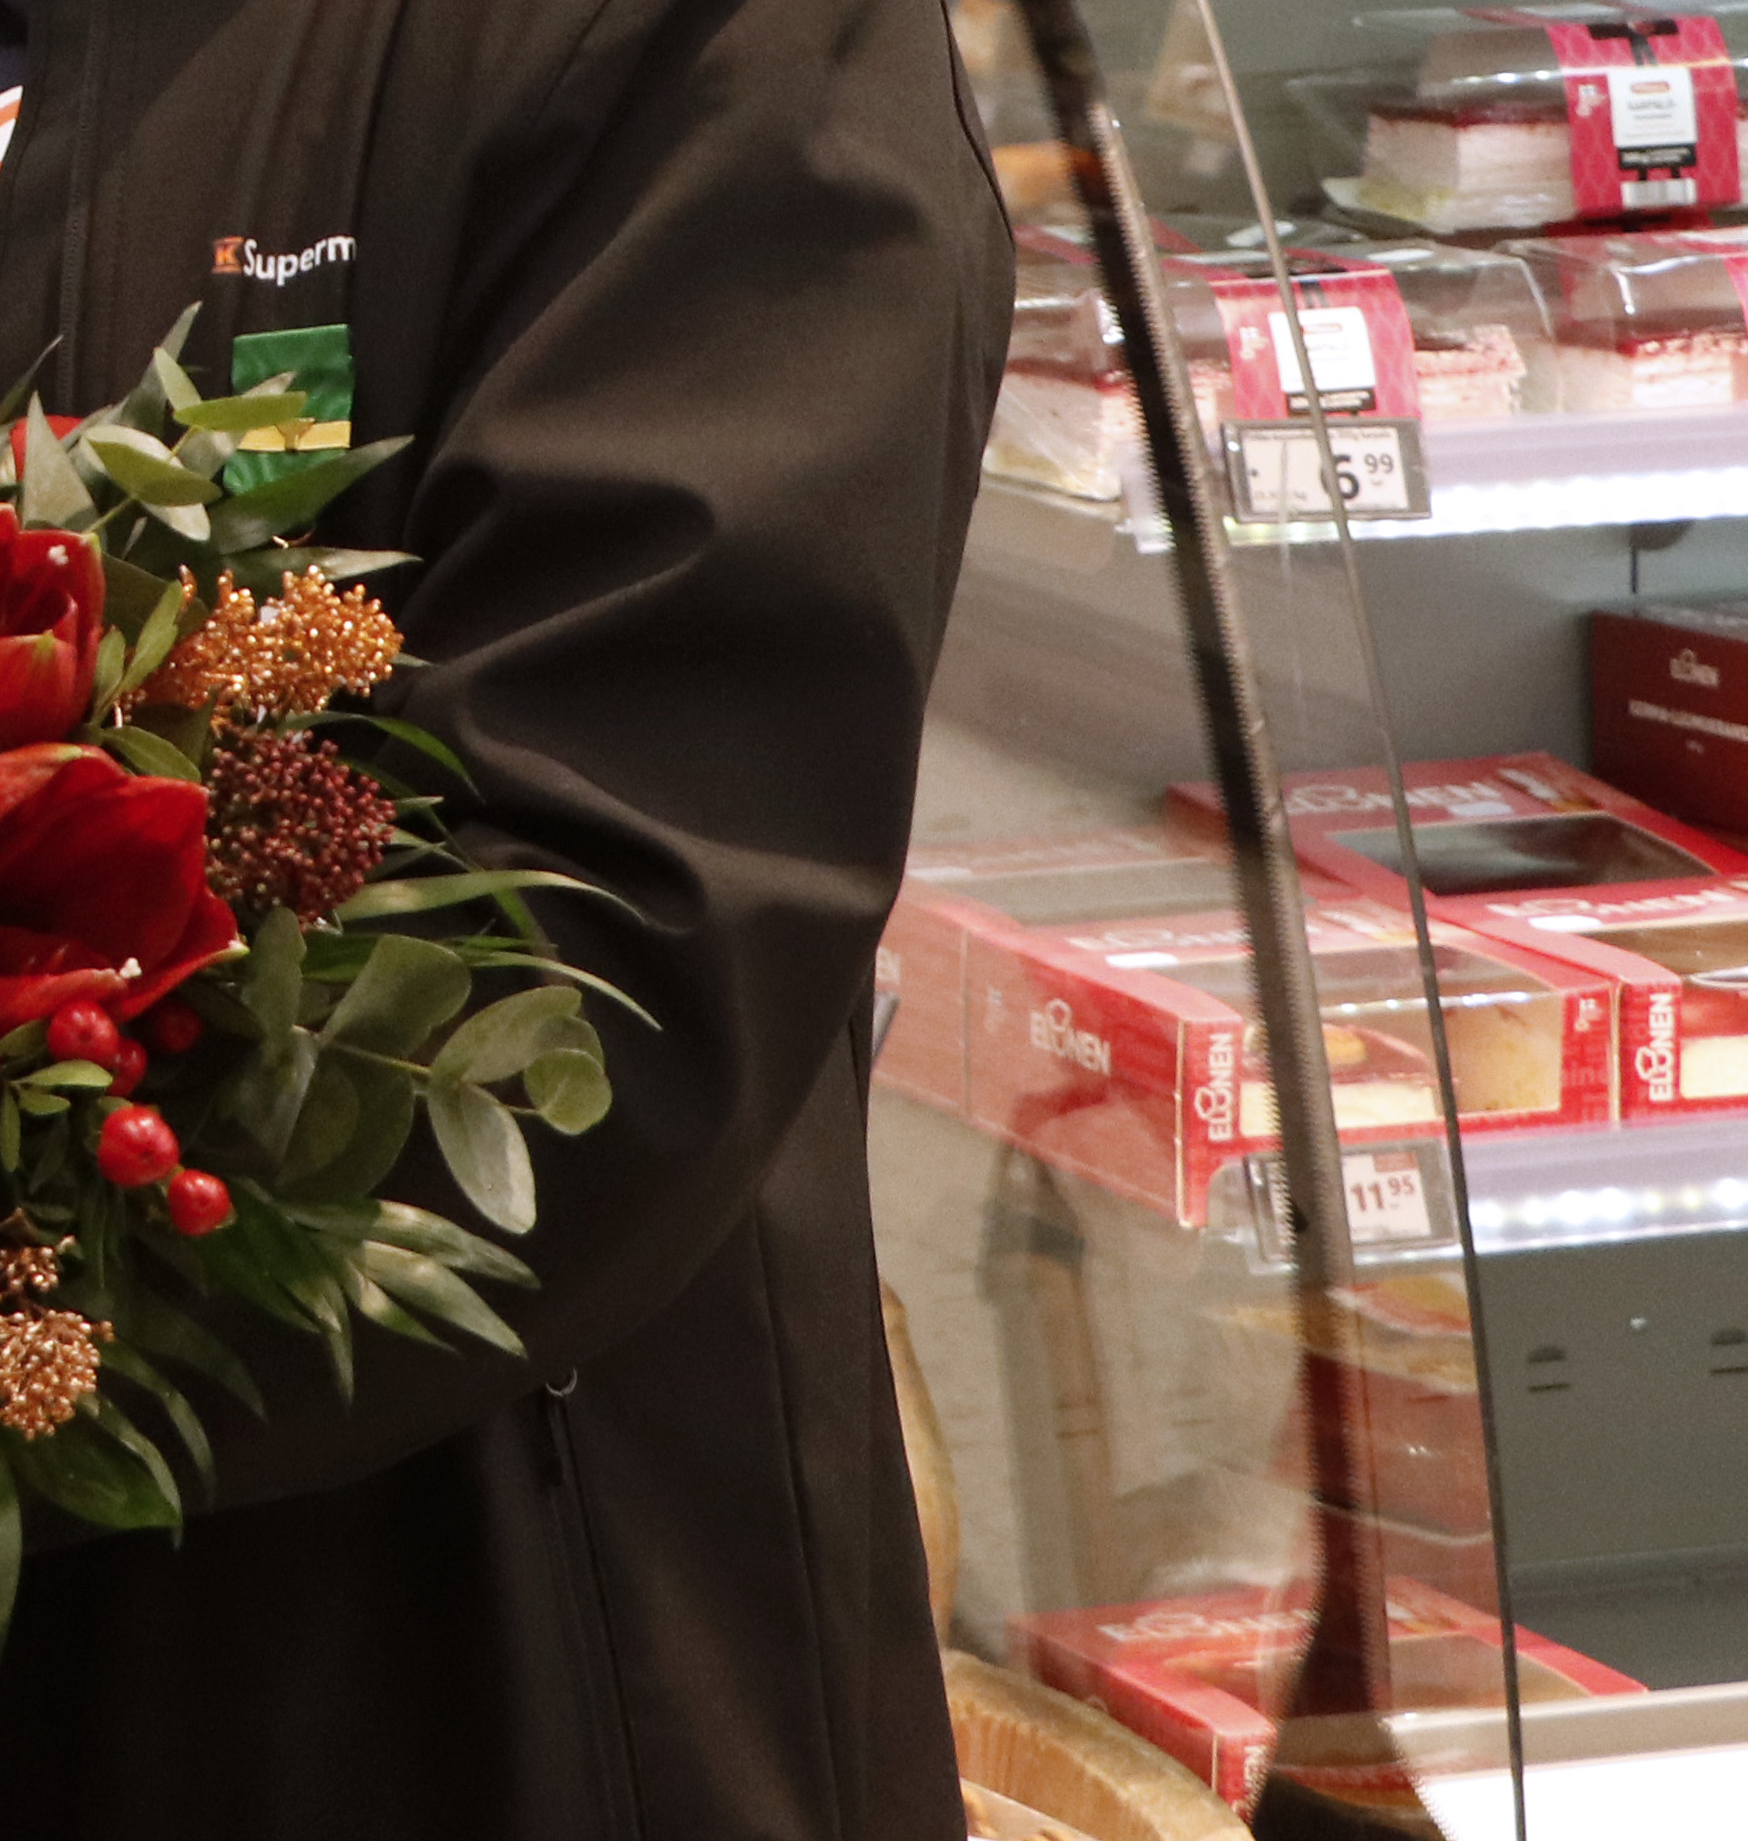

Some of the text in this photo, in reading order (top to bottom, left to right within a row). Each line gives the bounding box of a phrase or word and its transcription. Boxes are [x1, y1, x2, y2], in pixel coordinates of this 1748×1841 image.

[1364, 453, 1394, 474] 99
[1635, 993, 1674, 1101] ELONEN
[1195, 1033, 1233, 1141] ELONEN
[1350, 1176, 1415, 1212] 11 95
